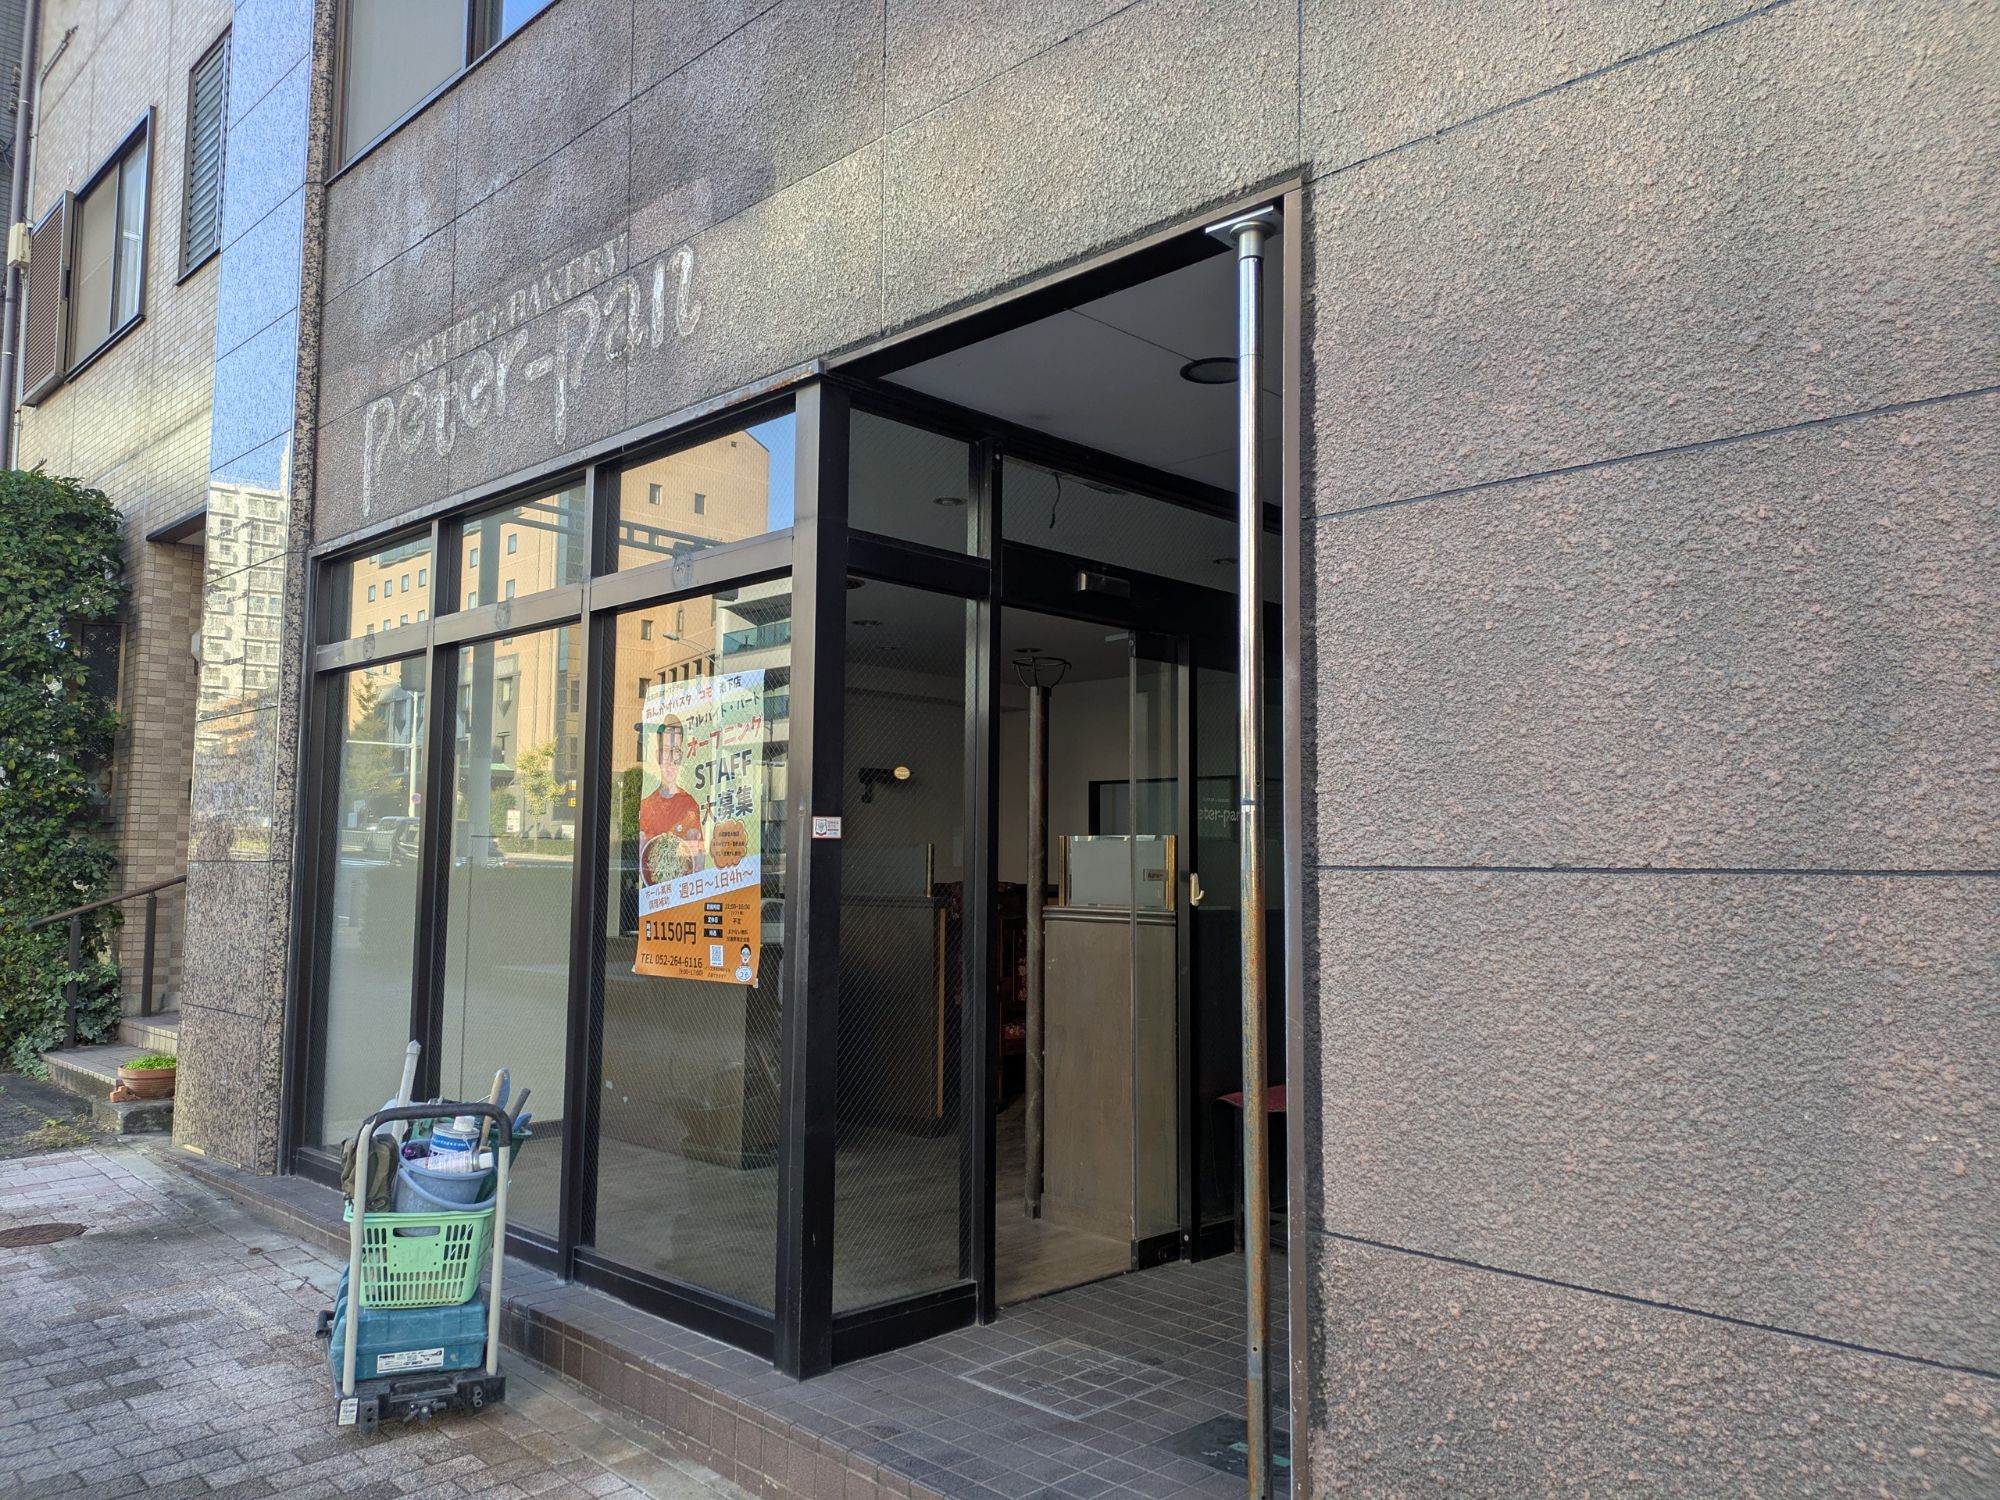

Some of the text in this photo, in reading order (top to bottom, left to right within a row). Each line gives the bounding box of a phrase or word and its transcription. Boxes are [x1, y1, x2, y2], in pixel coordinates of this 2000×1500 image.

[646, 694, 692, 719] あんかけパスタ
[699, 686, 713, 700] コモ
[685, 691, 760, 731] アルバイト・パート
[687, 714, 762, 759] オープニング
[695, 748, 753, 790] STAFF
[701, 785, 754, 826] 大募集
[653, 921, 697, 944] 1150円
[640, 953, 703, 969] TEL 052-264-6116
